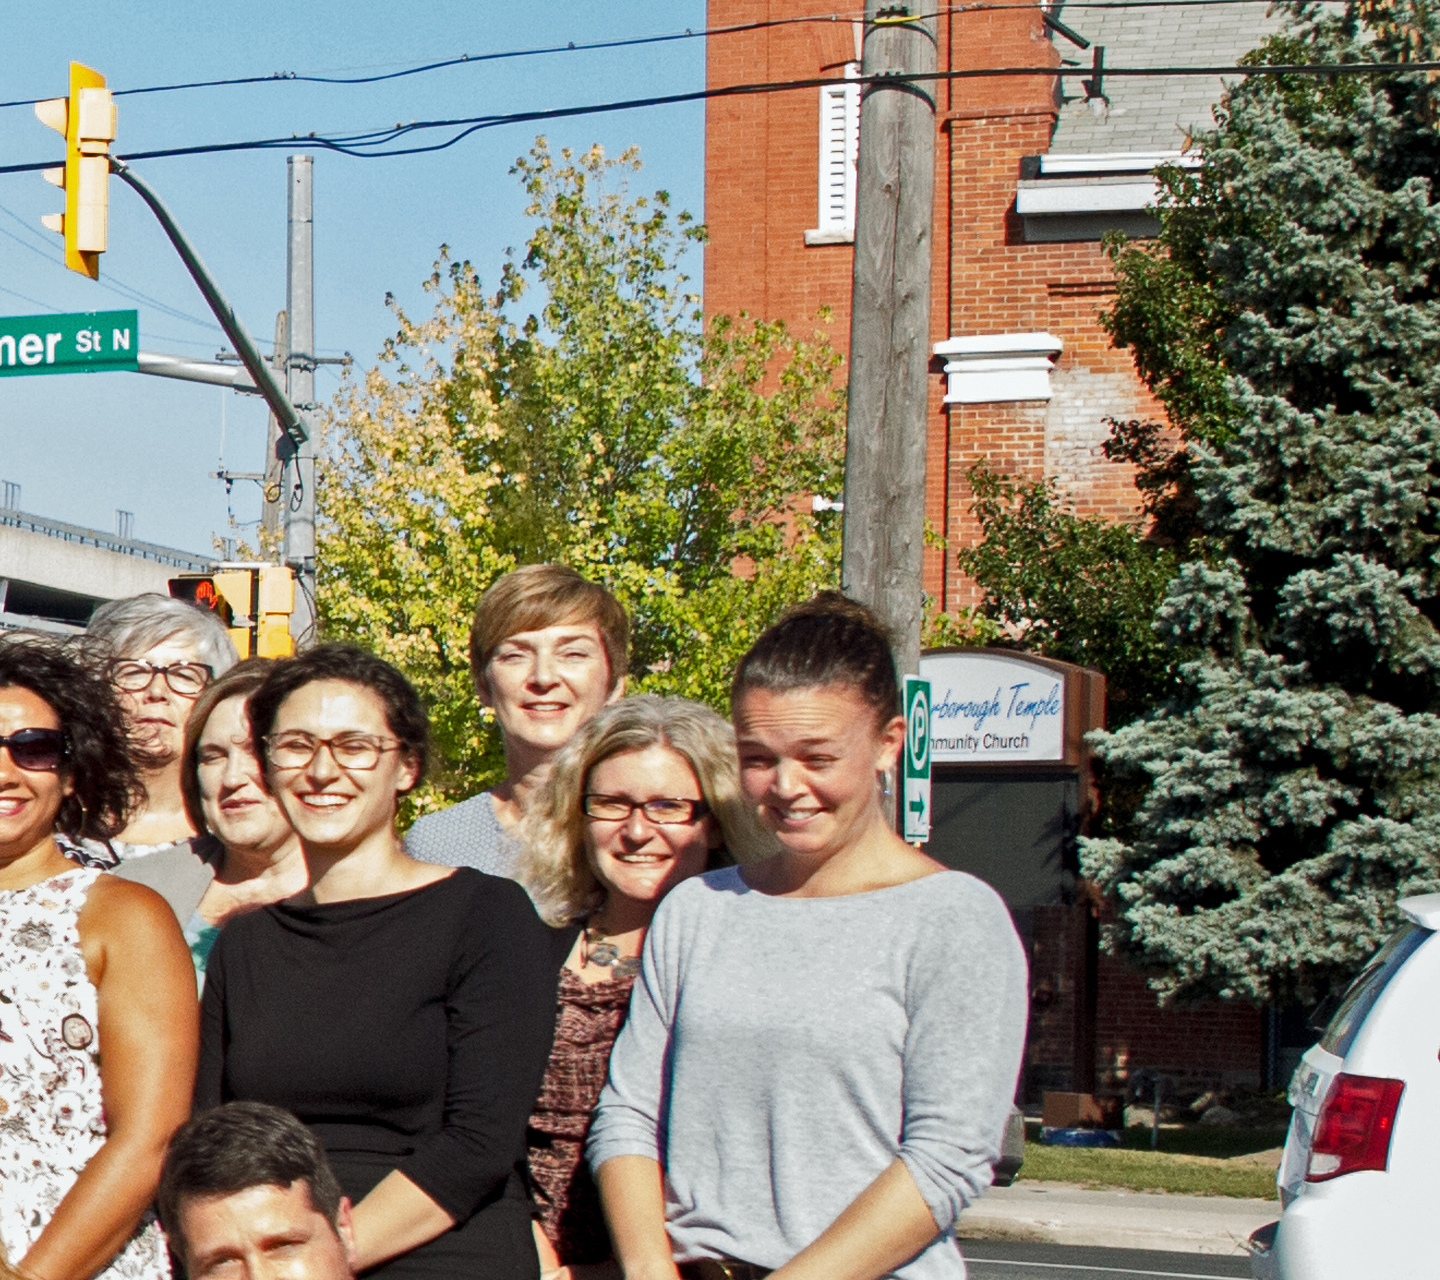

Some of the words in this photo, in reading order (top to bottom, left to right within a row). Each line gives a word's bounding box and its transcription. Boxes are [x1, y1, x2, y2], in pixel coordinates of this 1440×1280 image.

[76, 330, 102, 353] St
[113, 328, 131, 351] N
[931, 687, 1002, 731] rborough
[1006, 682, 1062, 730] Temple
[982, 732, 1030, 750] Church
